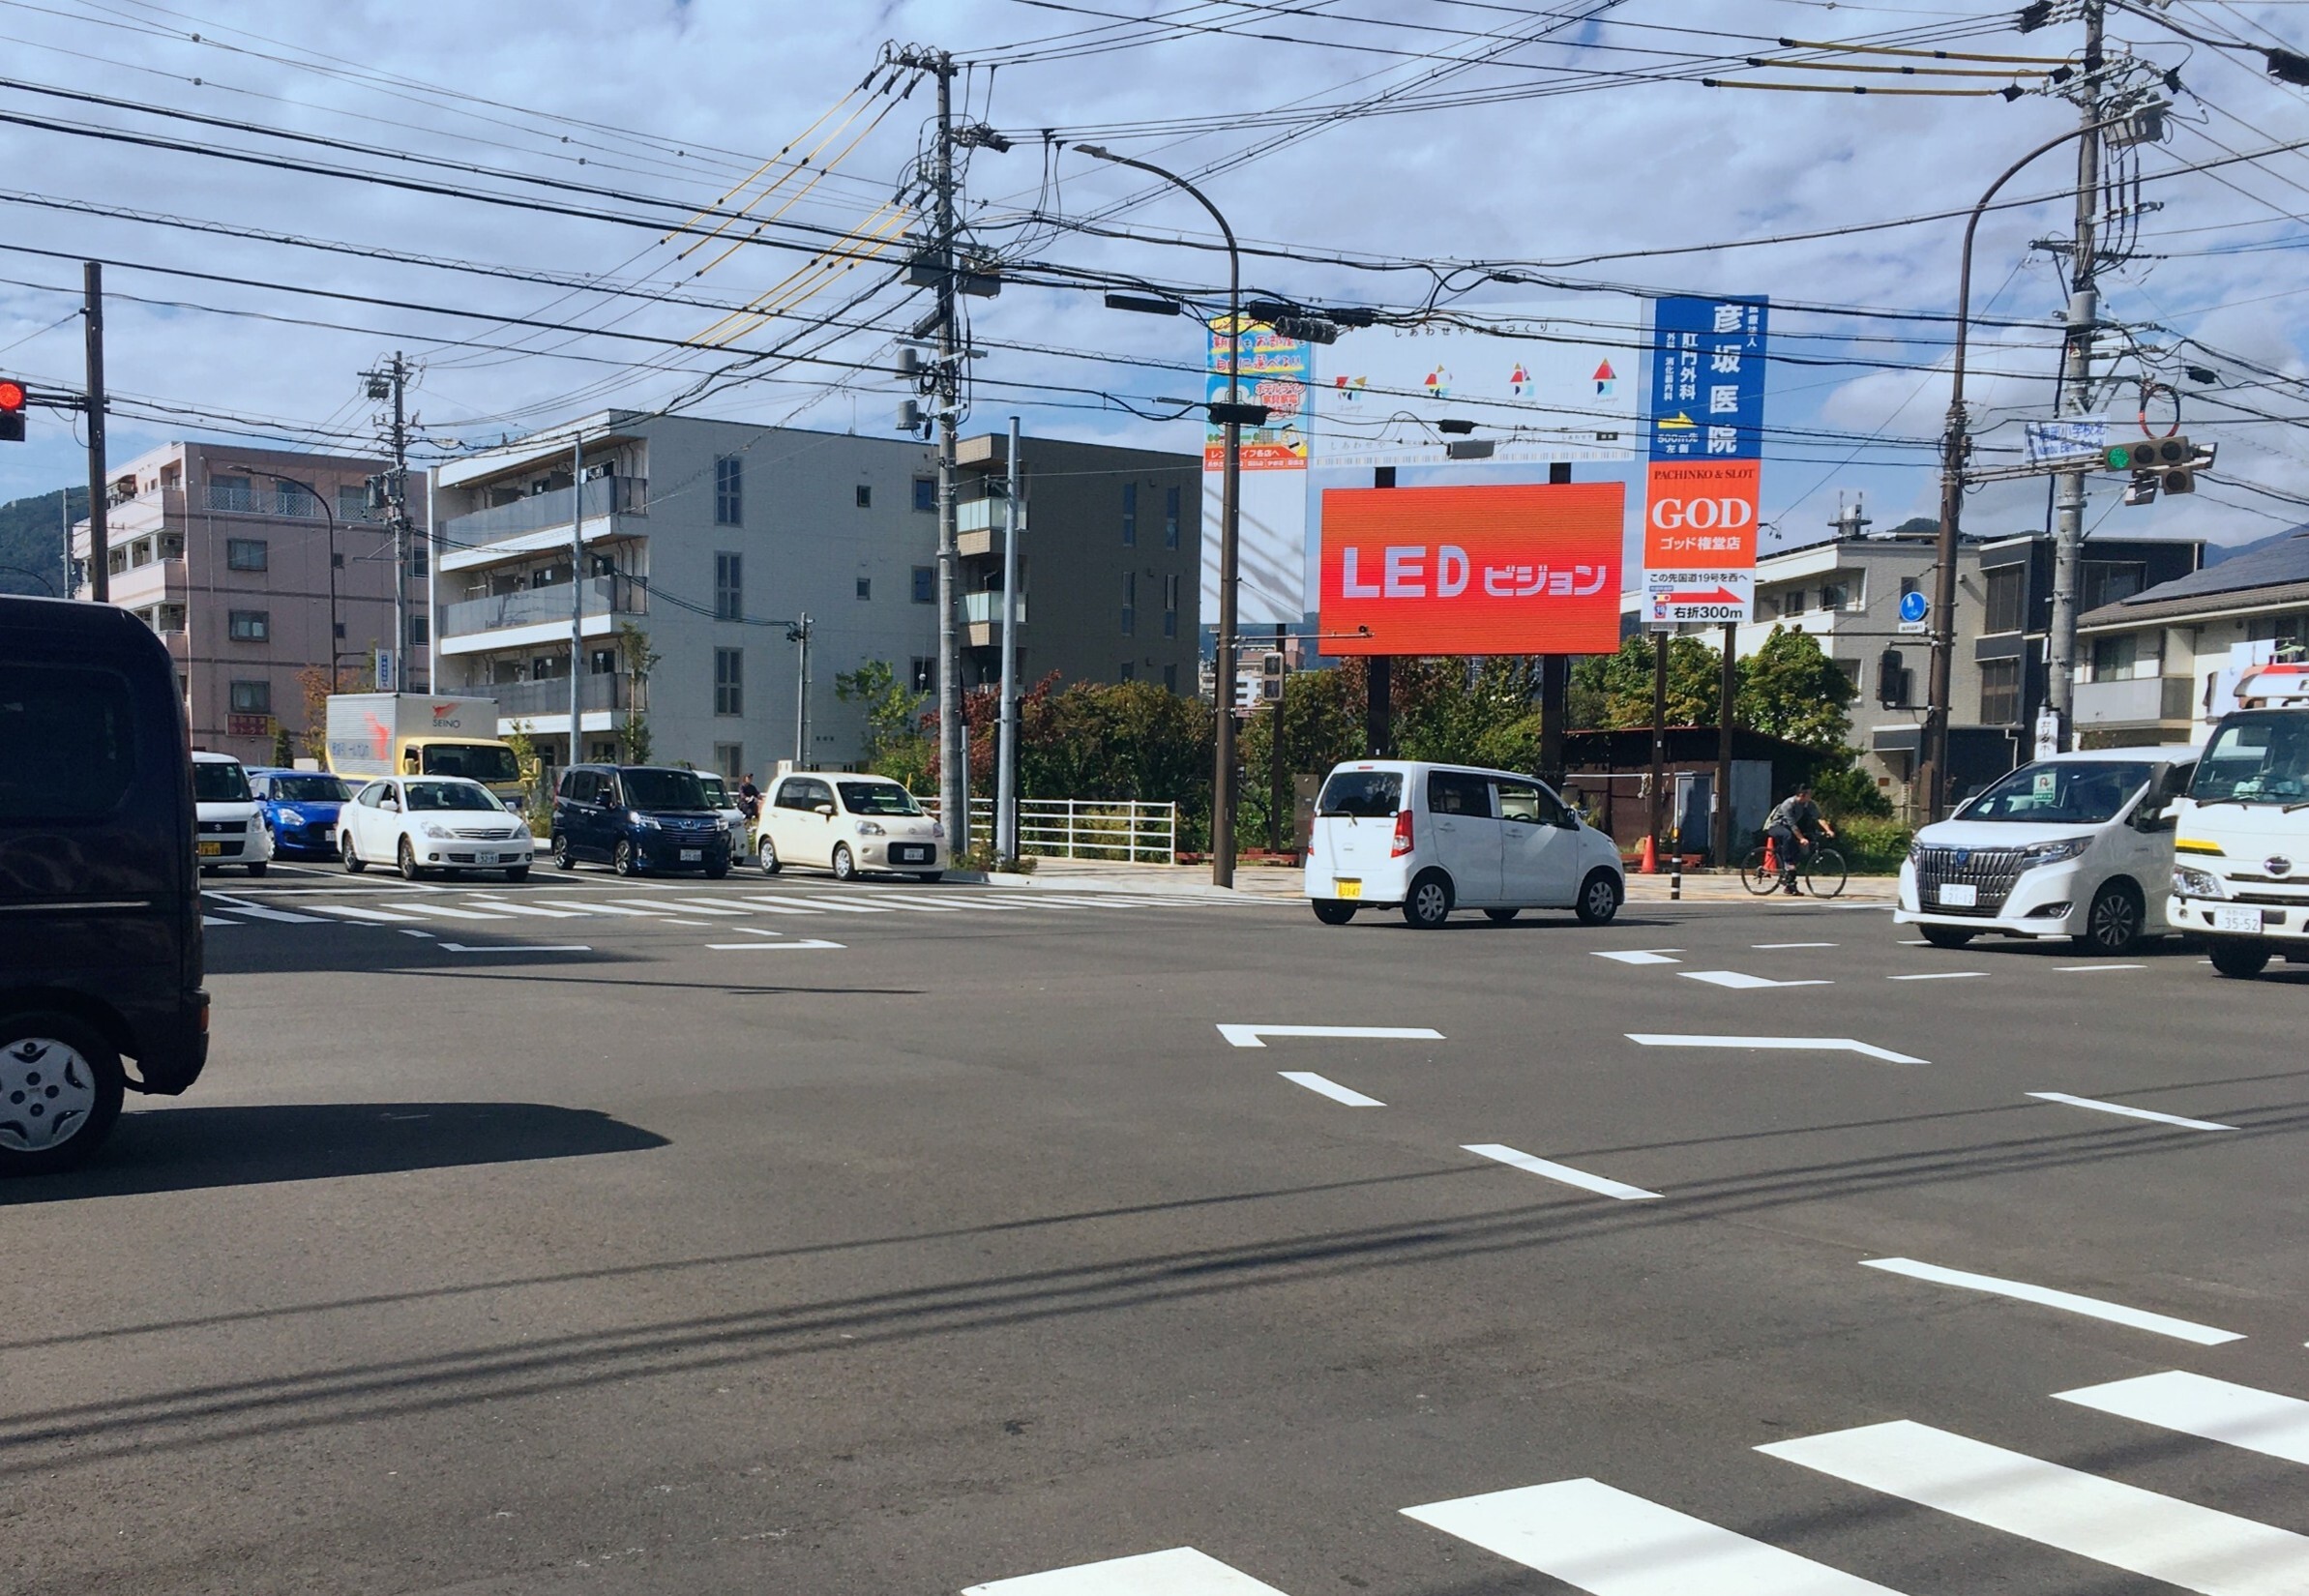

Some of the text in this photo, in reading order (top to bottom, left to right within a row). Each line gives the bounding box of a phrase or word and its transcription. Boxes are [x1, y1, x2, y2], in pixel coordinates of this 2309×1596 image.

[1679, 332, 1699, 400] 肛門外科
[1707, 304, 1743, 454] 彦坂医院
[1211, 448, 1280, 458] レンイフ各店へ
[1654, 469, 1755, 480] PACHINKO & SLOT
[1652, 497, 1752, 529] GOD
[1660, 536, 1741, 550] ゴッド権堂店
[1343, 545, 1607, 598] LED ビジョン
[1649, 573, 1748, 583] この先国道19号を西へ
[1673, 606, 1743, 619] 右折300m
[432, 719, 460, 728] SEINO
[2225, 917, 2260, 931] 35-52
